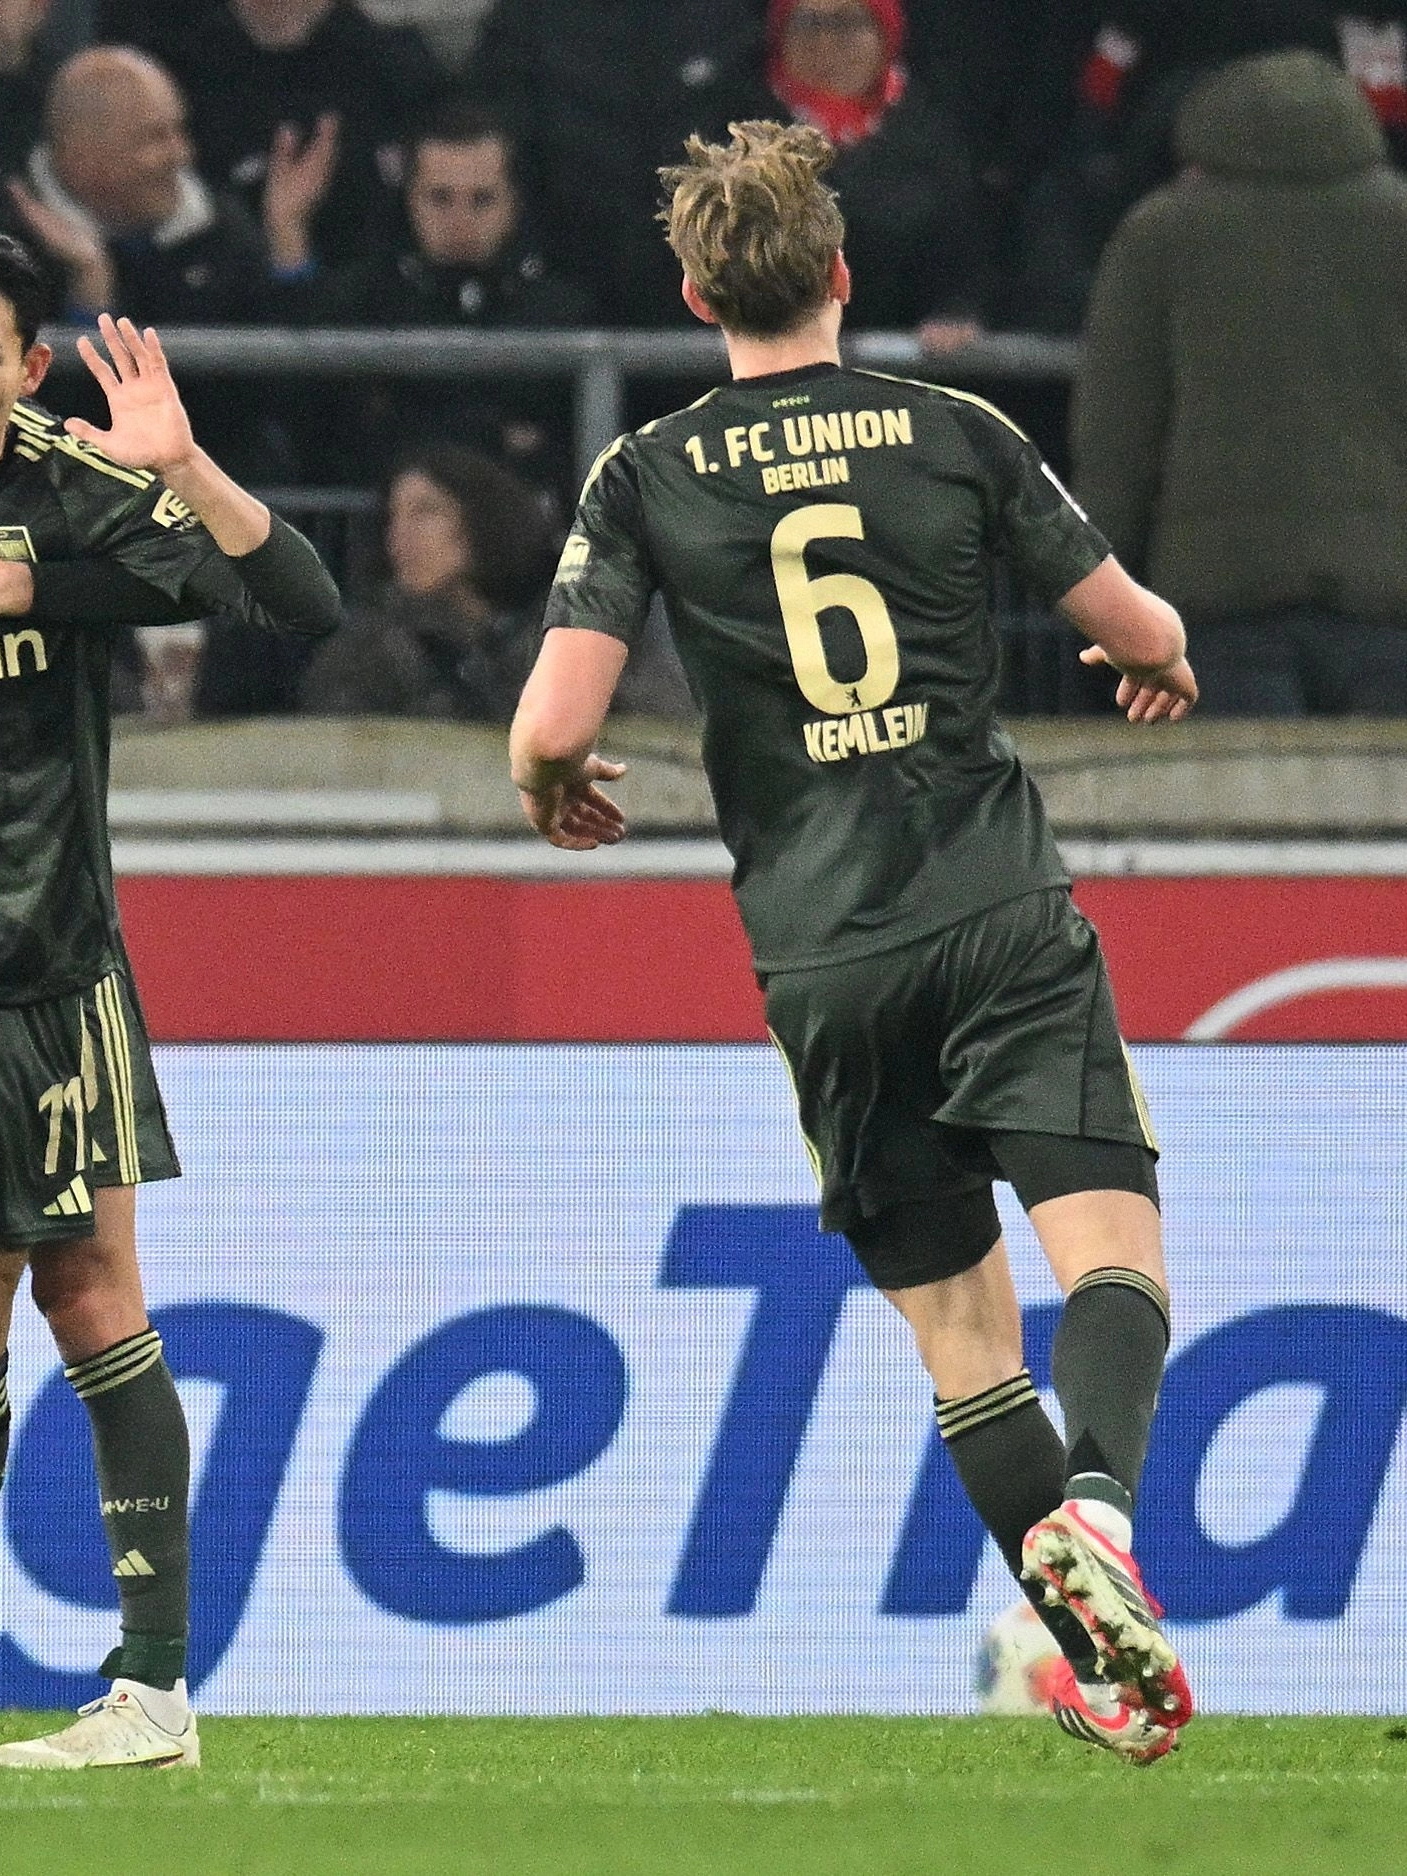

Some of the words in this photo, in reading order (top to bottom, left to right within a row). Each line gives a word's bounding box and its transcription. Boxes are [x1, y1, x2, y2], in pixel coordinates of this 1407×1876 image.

[685, 435, 721, 474] 1.
[724, 421, 775, 468] FC
[782, 408, 913, 456] UNION
[762, 456, 850, 495] BERLIN
[769, 502, 900, 716] 6
